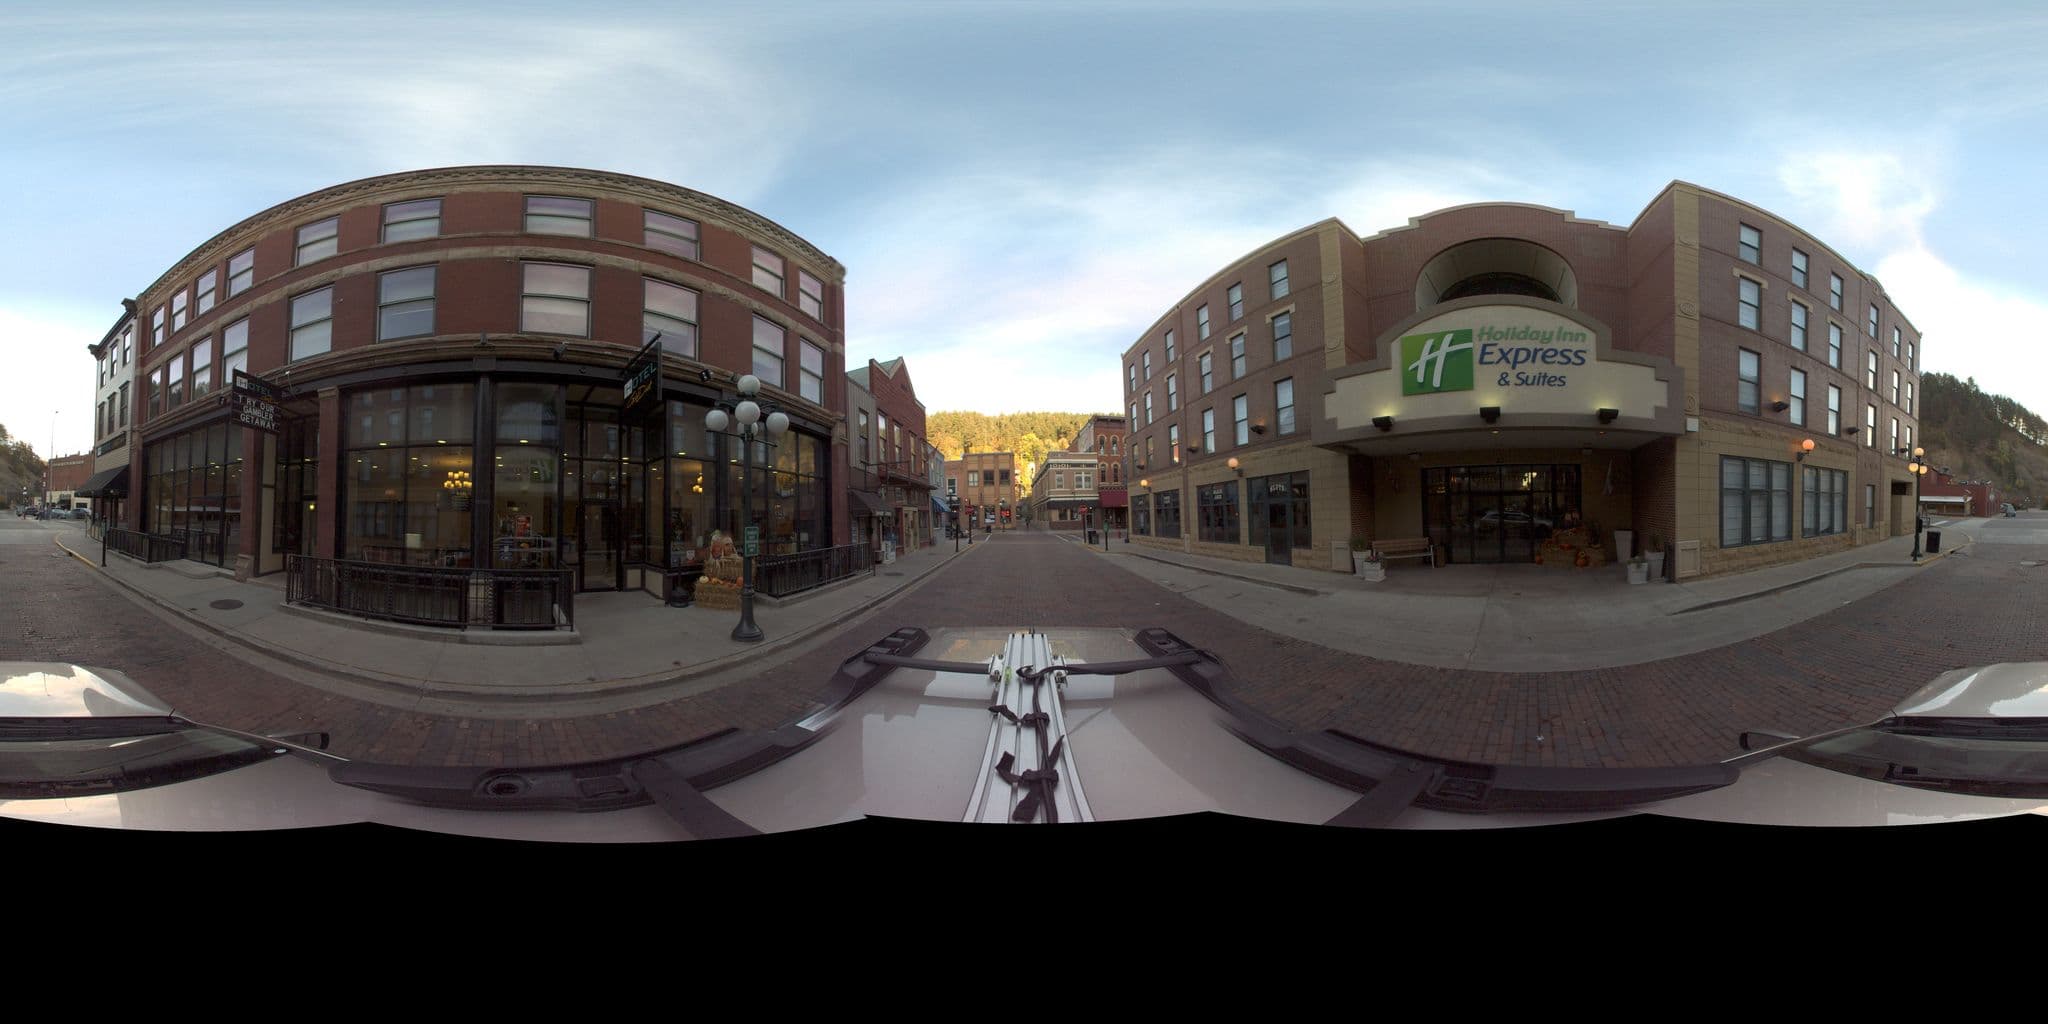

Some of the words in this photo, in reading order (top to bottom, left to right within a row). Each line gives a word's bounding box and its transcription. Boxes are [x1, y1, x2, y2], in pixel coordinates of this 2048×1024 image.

[1478, 325, 1555, 344] Holiday
[1555, 326, 1588, 342] Inn
[1478, 343, 1587, 370] Express
[624, 363, 656, 400] HOTEL
[1497, 372, 1510, 387] &
[1514, 371, 1567, 387] Suites
[243, 405, 274, 422] GAMBLER
[260, 402, 275, 413] OUR
[240, 413, 275, 430] GETAWAY
